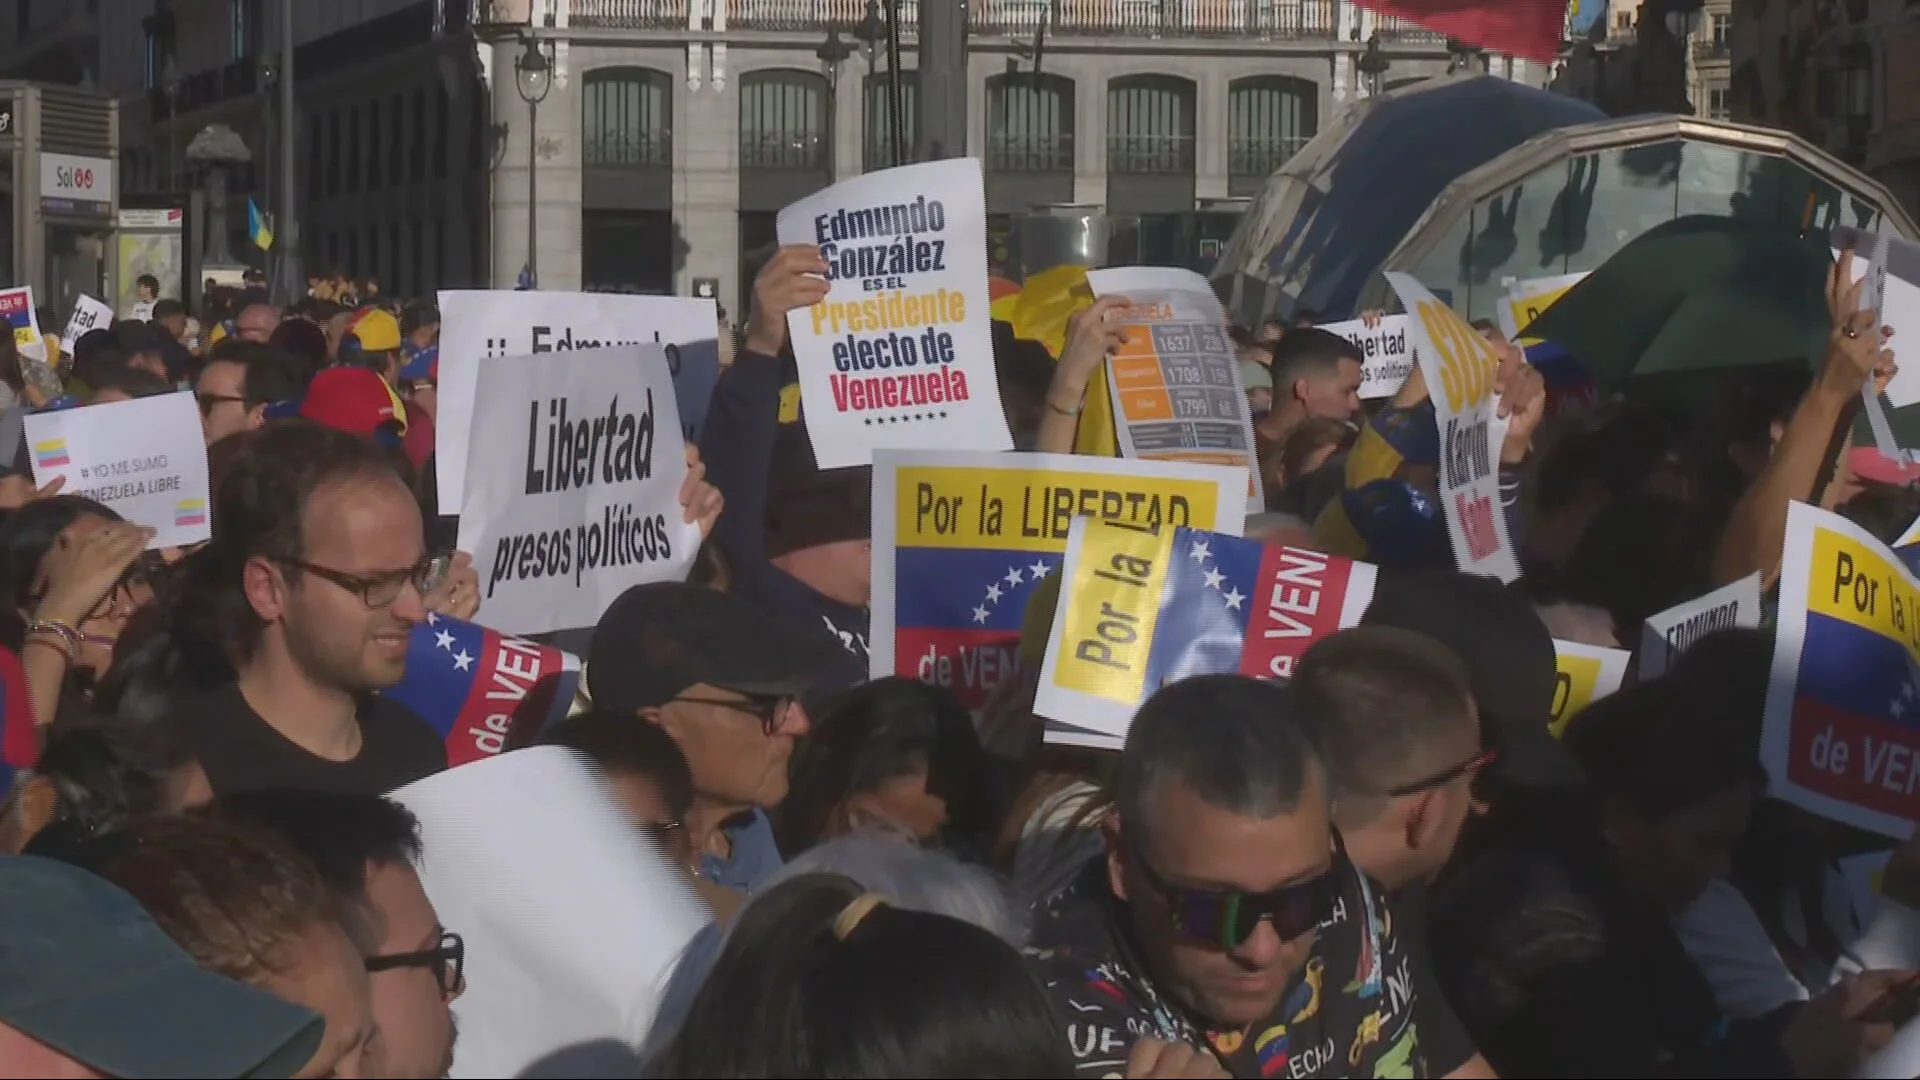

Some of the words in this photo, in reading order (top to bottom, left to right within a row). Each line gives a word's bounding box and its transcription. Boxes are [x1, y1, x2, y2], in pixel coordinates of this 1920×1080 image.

[57, 165, 73, 188] Sol
[814, 195, 946, 244] Edmundo
[819, 236, 946, 281] González
[862, 277, 883, 291] ES
[886, 275, 907, 290] EL
[809, 288, 967, 336] Presidente
[832, 331, 917, 372] electo
[920, 326, 955, 365] de
[1158, 335, 1192, 352] 1637
[829, 365, 970, 412] Venezuela
[1166, 366, 1201, 384] 1708
[1175, 398, 1209, 416] 1799
[525, 387, 654, 495] Libertad
[92, 464, 109, 478] YO
[110, 460, 130, 476] ME
[132, 454, 169, 473] SUMO
[148, 475, 182, 494] LIBRE
[916, 482, 963, 535] Por
[978, 485, 1004, 536] la
[487, 527, 572, 598] presos
[577, 503, 672, 588] políticos
[1094, 553, 1153, 587] la
[1833, 550, 1879, 617] Por
[1888, 575, 1905, 633] la
[1075, 601, 1141, 671] Por
[918, 643, 952, 689] de
[469, 713, 513, 754] de
[1810, 725, 1849, 775] de
